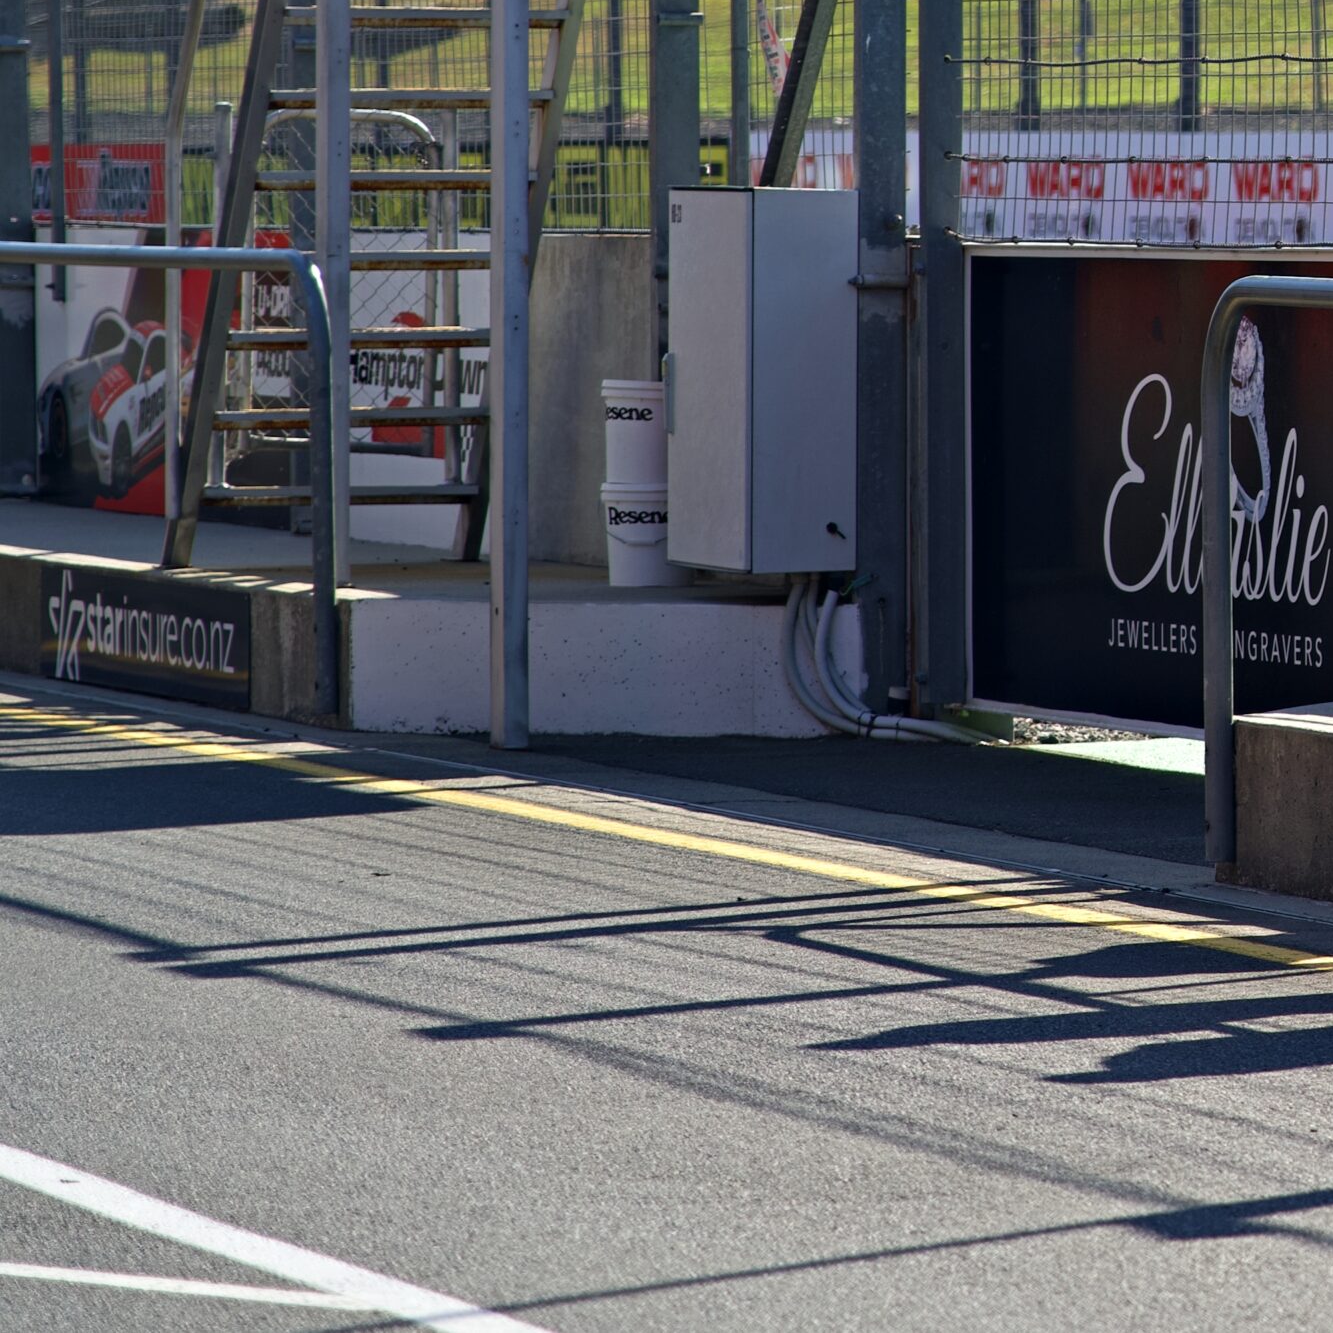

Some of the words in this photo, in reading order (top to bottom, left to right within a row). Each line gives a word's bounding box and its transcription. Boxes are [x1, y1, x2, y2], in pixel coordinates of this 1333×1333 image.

[1026, 156, 1104, 198] WARD
[1126, 156, 1209, 200] WARD
[1231, 156, 1320, 203] WARD
[605, 406, 653, 421] esene
[608, 506, 669, 526] Resen
[86, 592, 236, 674] starinsure.co.nz
[1108, 618, 1198, 656] JEWELLERS
[1234, 628, 1324, 669] NGRAVERS
